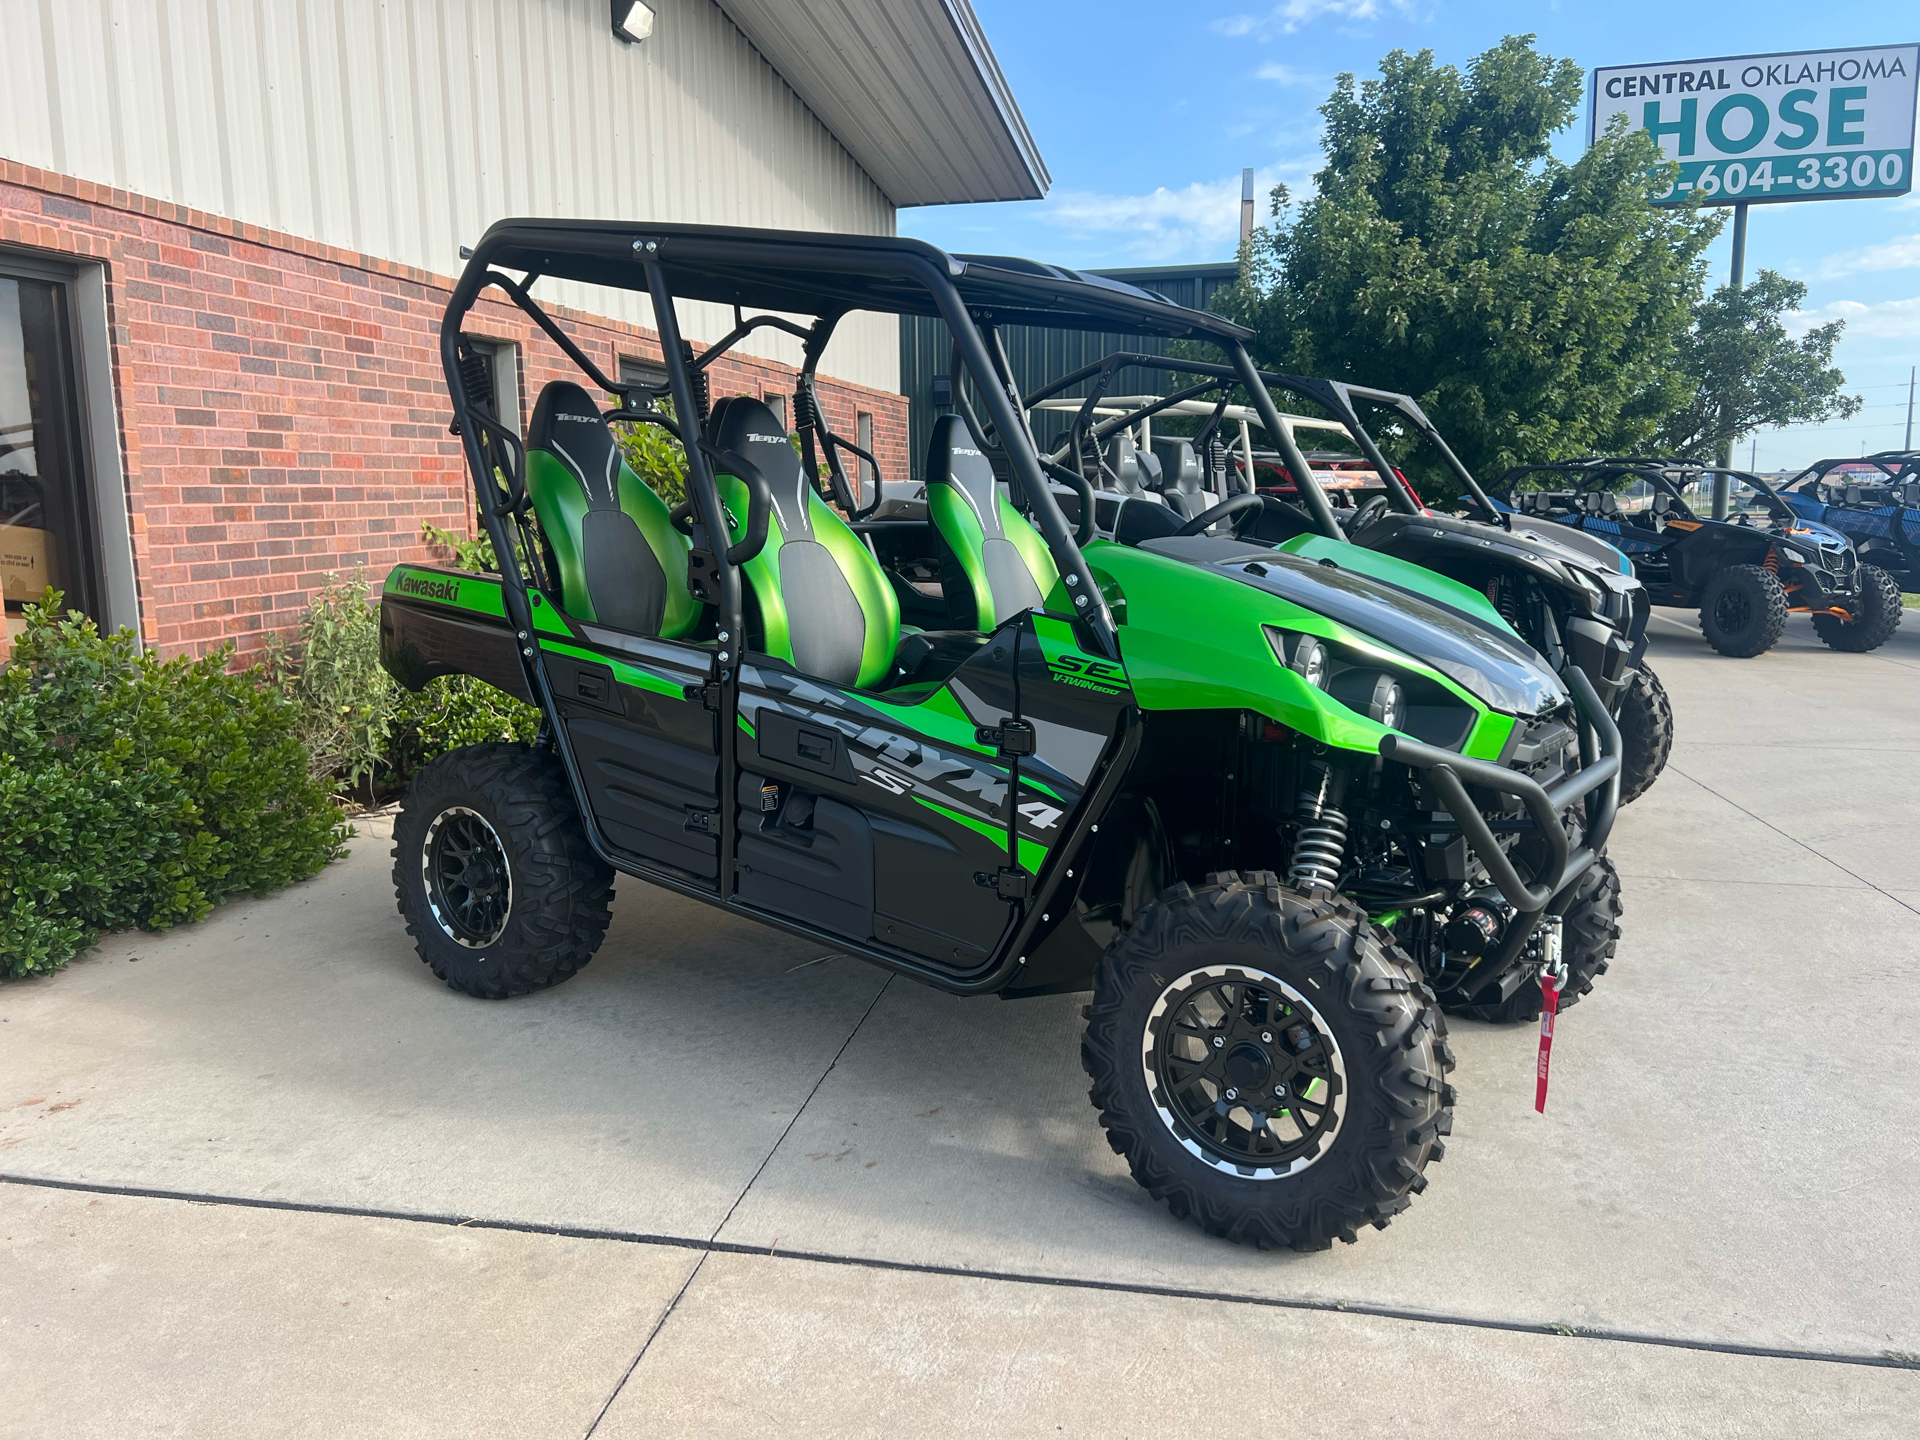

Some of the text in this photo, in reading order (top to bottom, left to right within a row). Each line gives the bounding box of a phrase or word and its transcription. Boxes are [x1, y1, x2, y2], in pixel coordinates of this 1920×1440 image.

[1605, 56, 1906, 99] CENTRAL OKLAHOMA
[1643, 86, 1868, 157] HOSE
[395, 571, 461, 602] Kawasaki
[1057, 655, 1121, 680] SE
[1018, 801, 1064, 829] 4
[1538, 1050, 1549, 1080] WARN
